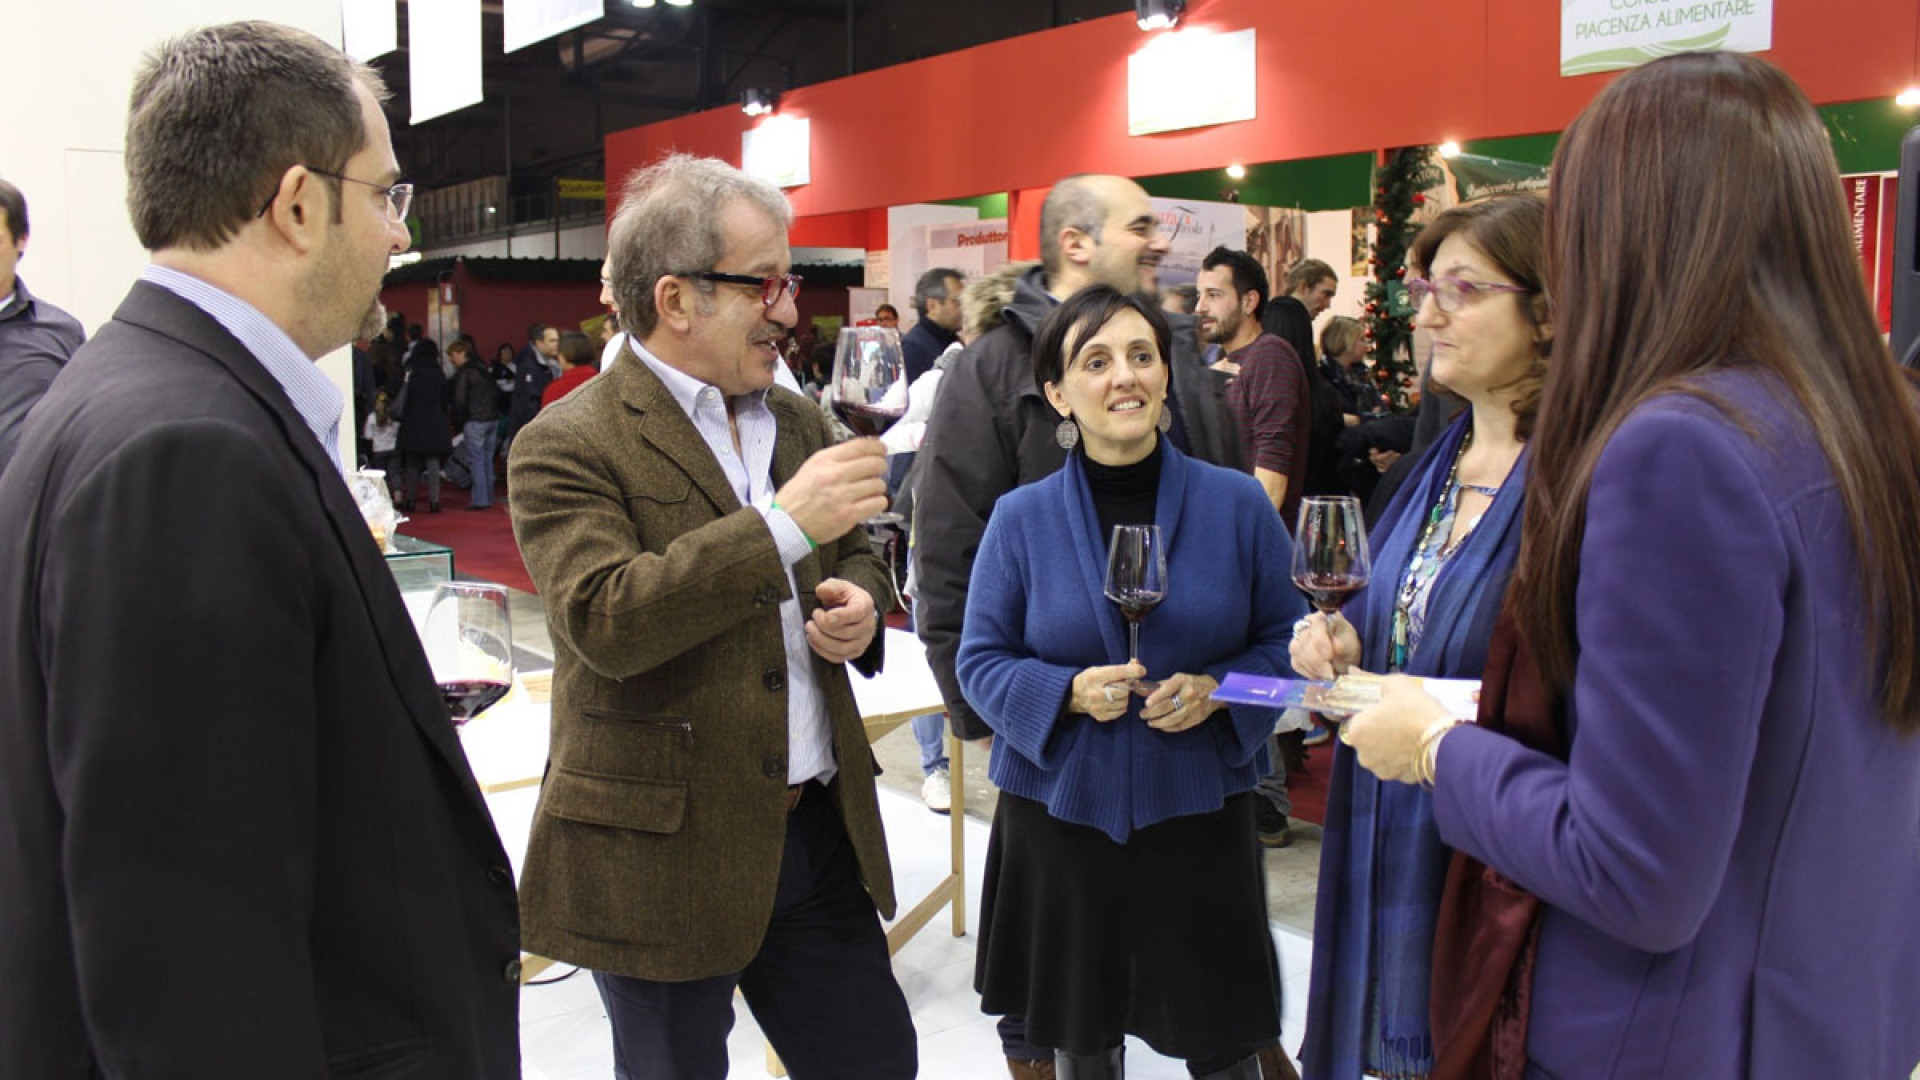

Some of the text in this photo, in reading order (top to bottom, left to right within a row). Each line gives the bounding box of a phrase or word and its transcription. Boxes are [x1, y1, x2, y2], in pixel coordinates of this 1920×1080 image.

[1575, 1, 1755, 40] PIACENZA ALIMENTARE
[957, 231, 1008, 247] Produttor
